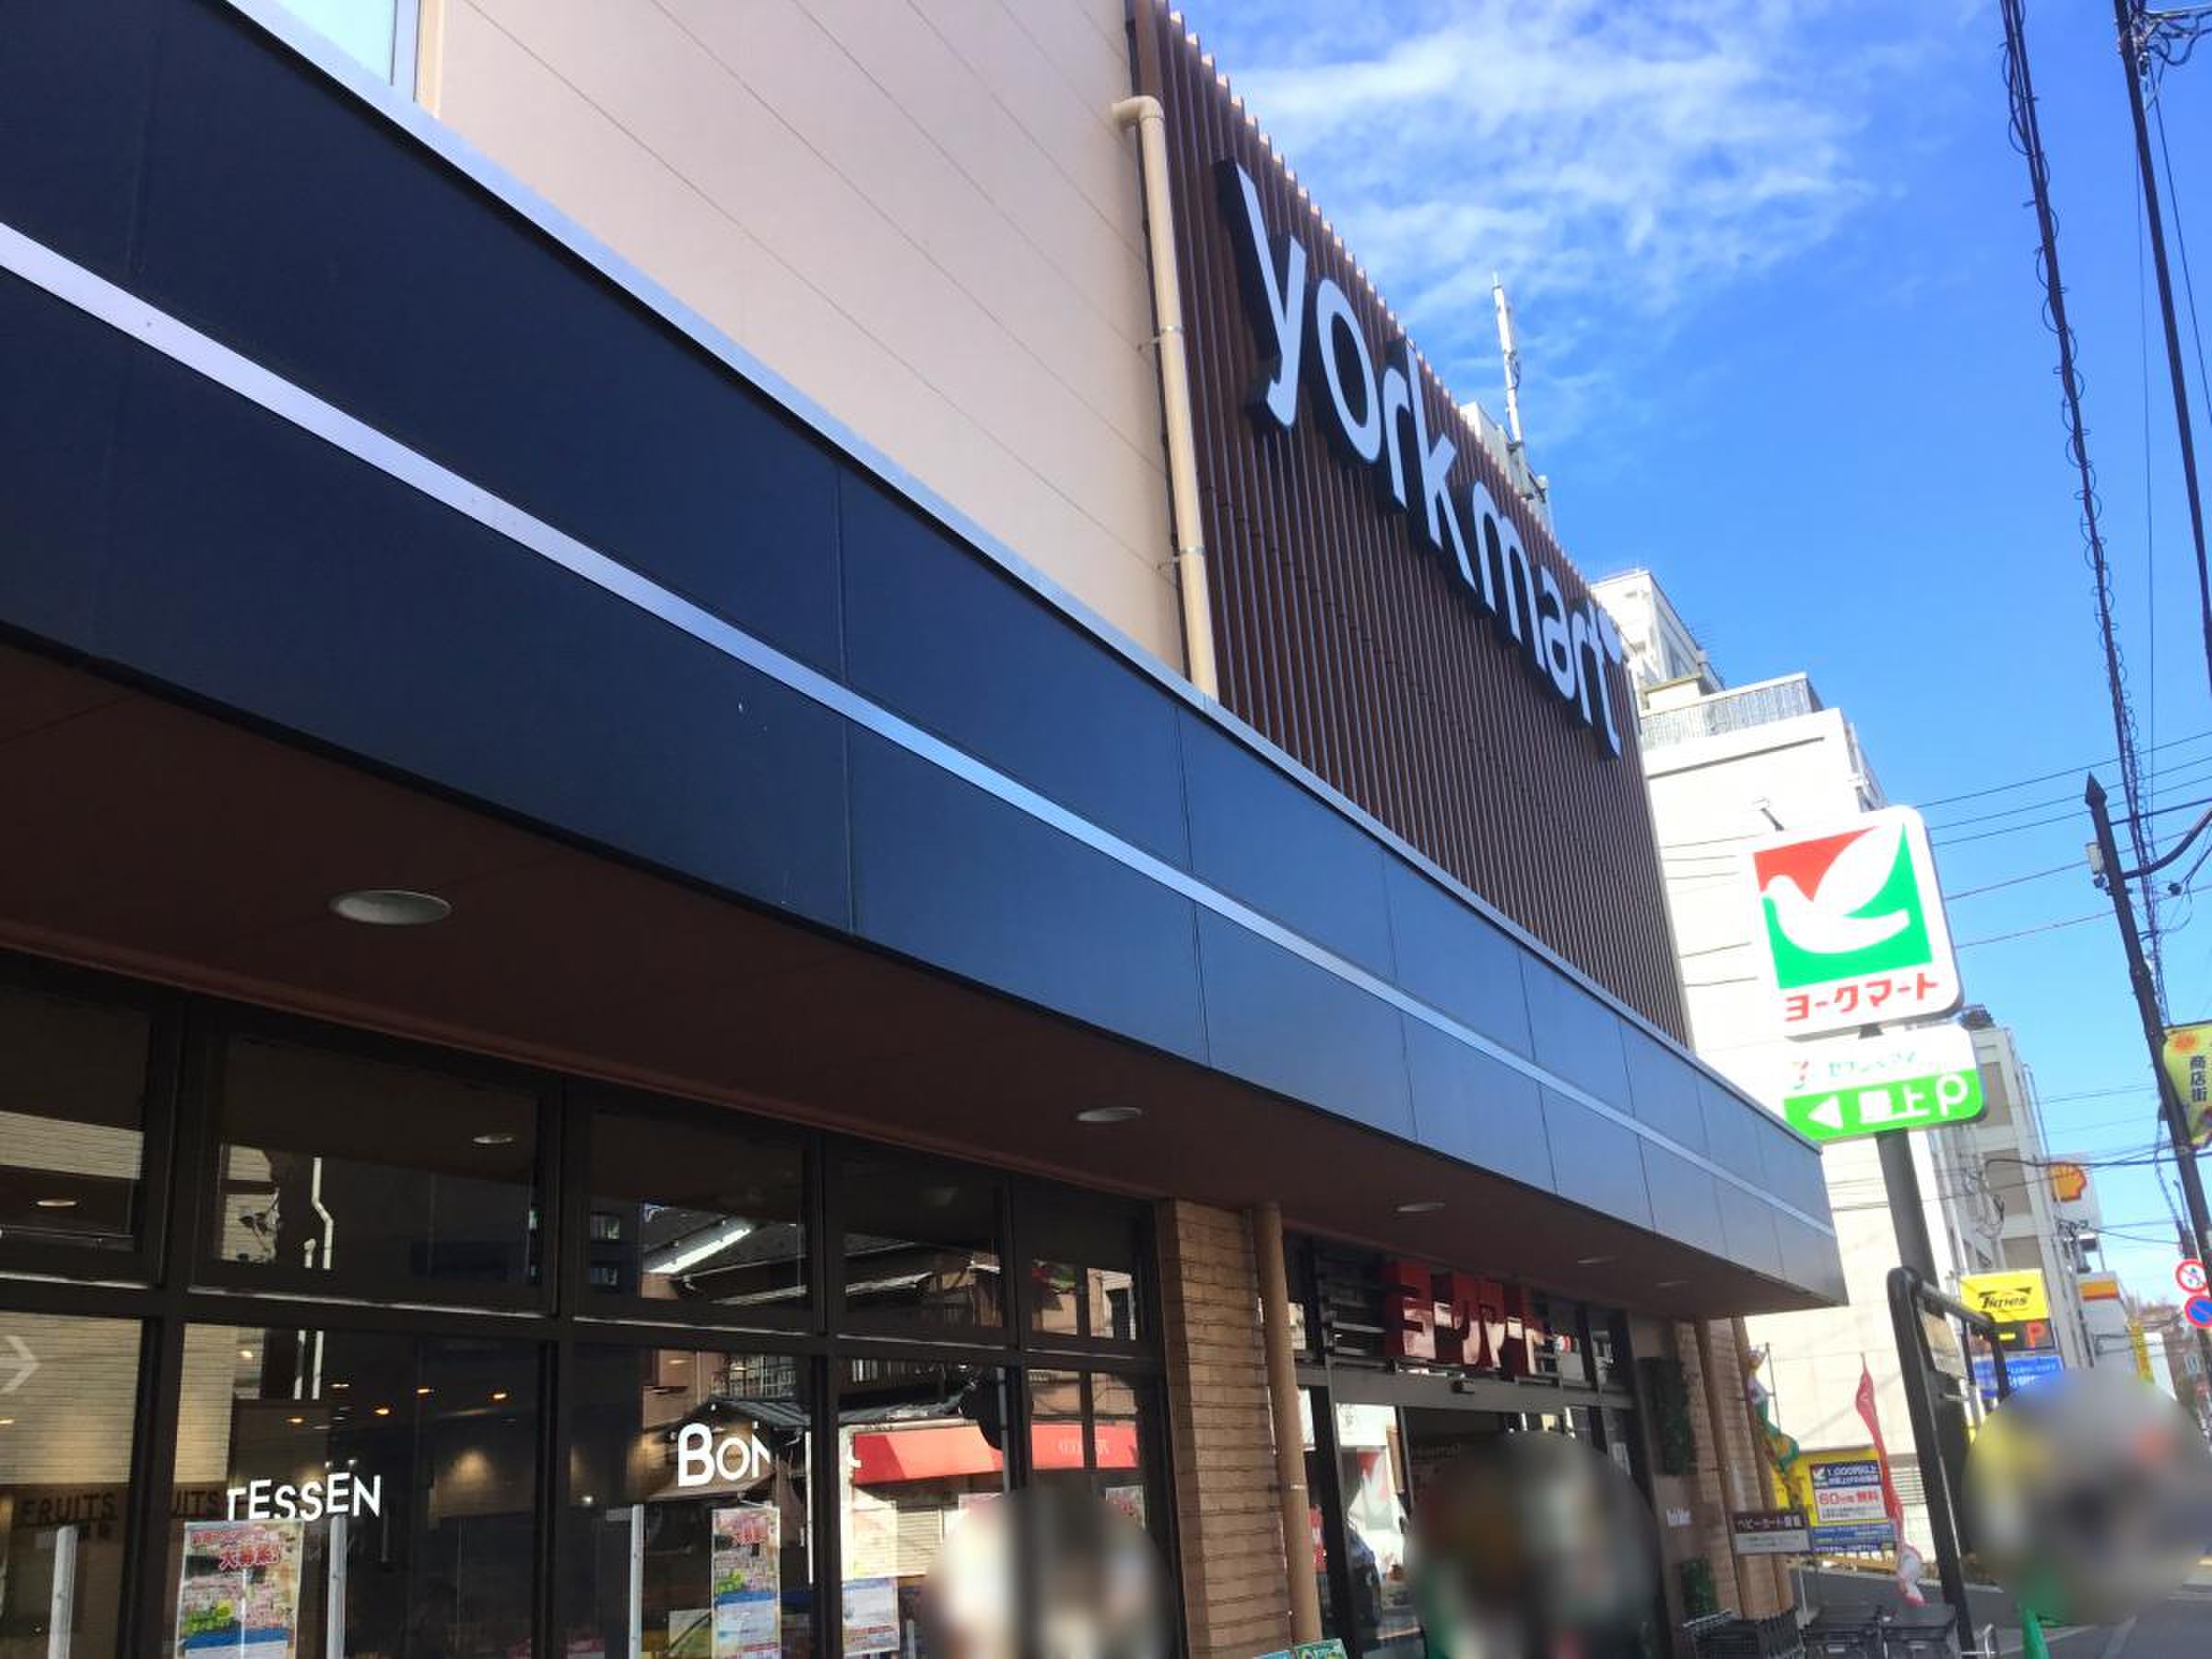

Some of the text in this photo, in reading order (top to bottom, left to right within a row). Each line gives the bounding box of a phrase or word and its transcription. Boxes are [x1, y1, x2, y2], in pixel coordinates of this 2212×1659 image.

[1784, 972, 1939, 1022] ヨークマート
[1978, 1288, 2031, 1310] Times
[2024, 1319, 2046, 1349] P
[20, 1491, 118, 1523] FRUITS
